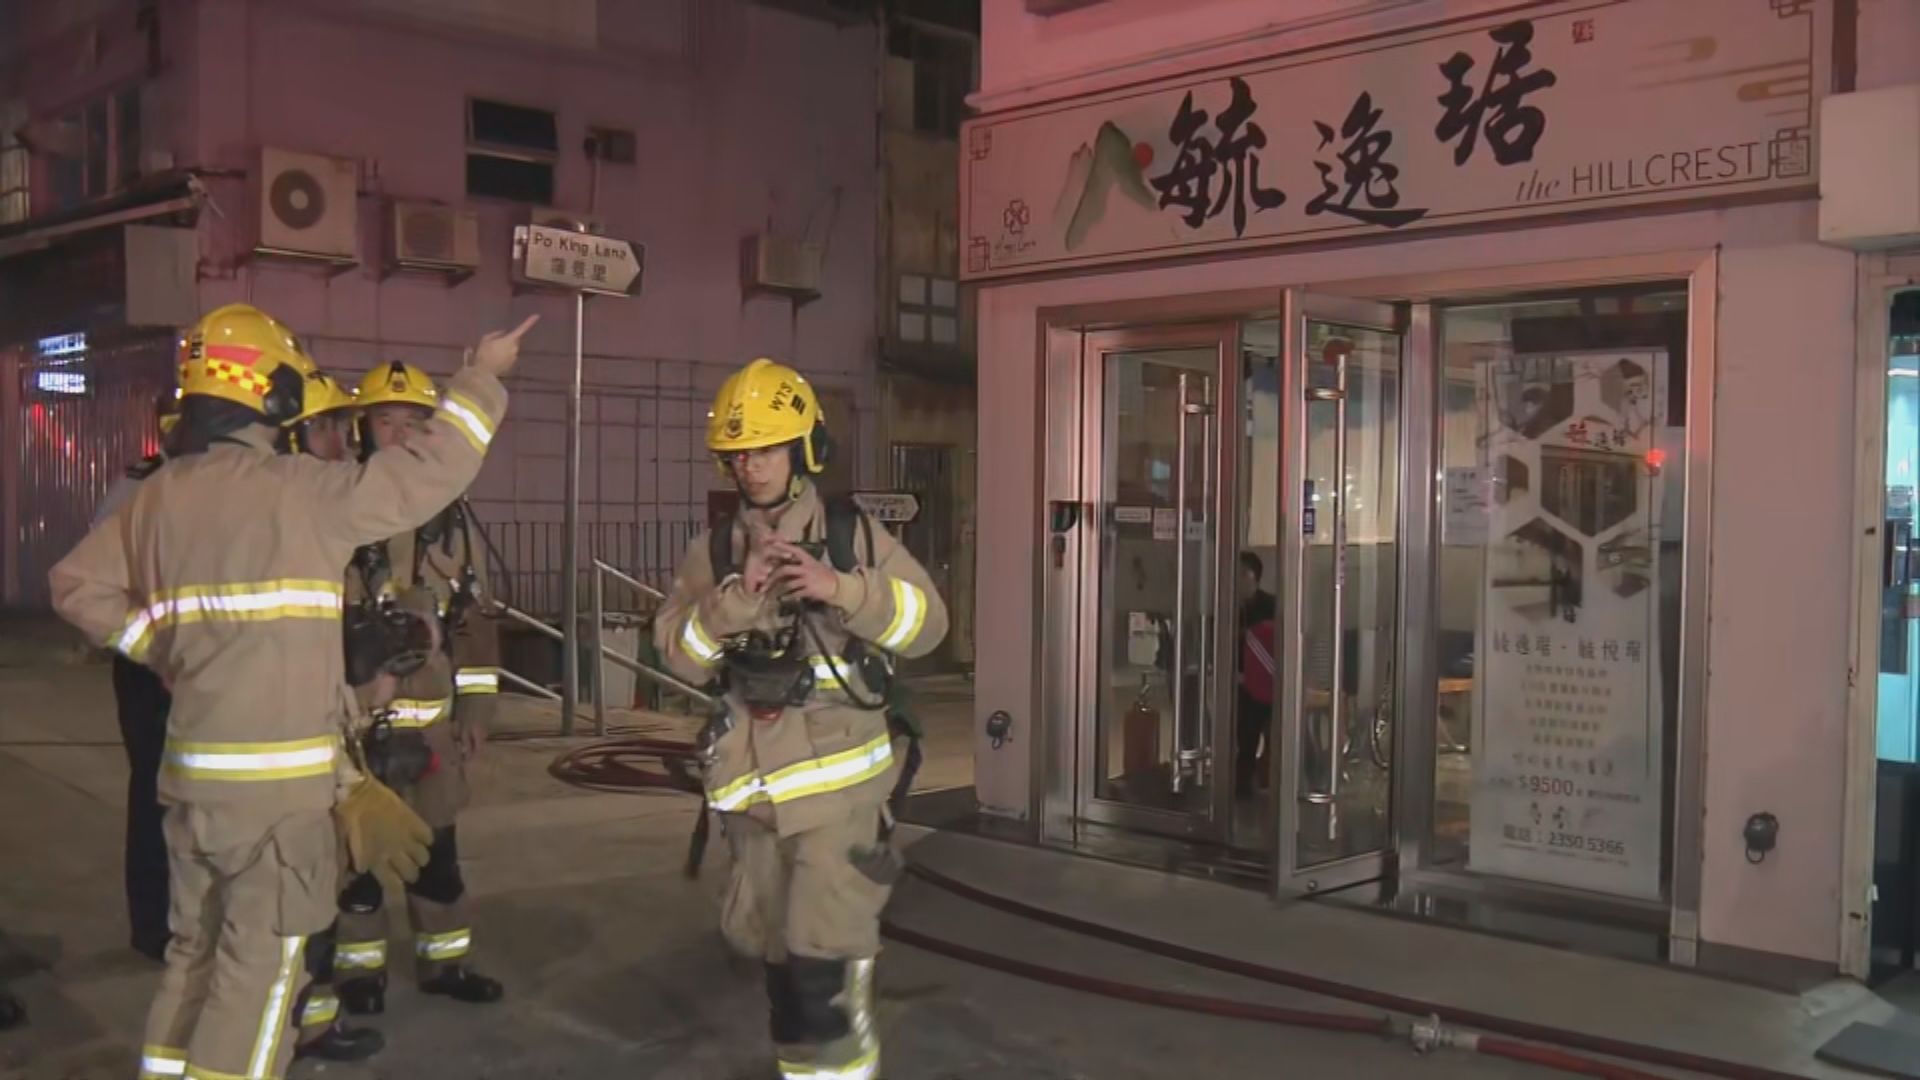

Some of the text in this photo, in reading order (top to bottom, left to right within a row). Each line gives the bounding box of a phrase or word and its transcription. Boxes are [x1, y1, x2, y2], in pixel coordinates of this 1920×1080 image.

[1150, 19, 1557, 239] 毓逸琚
[1515, 141, 1761, 202] the HILLCREST
[534, 231, 553, 248] Po
[559, 237, 589, 257] King
[768, 381, 793, 412] WTS
[1519, 774, 1574, 797] $9500
[1549, 831, 1583, 850] 2350
[1587, 837, 1625, 856] 5366
